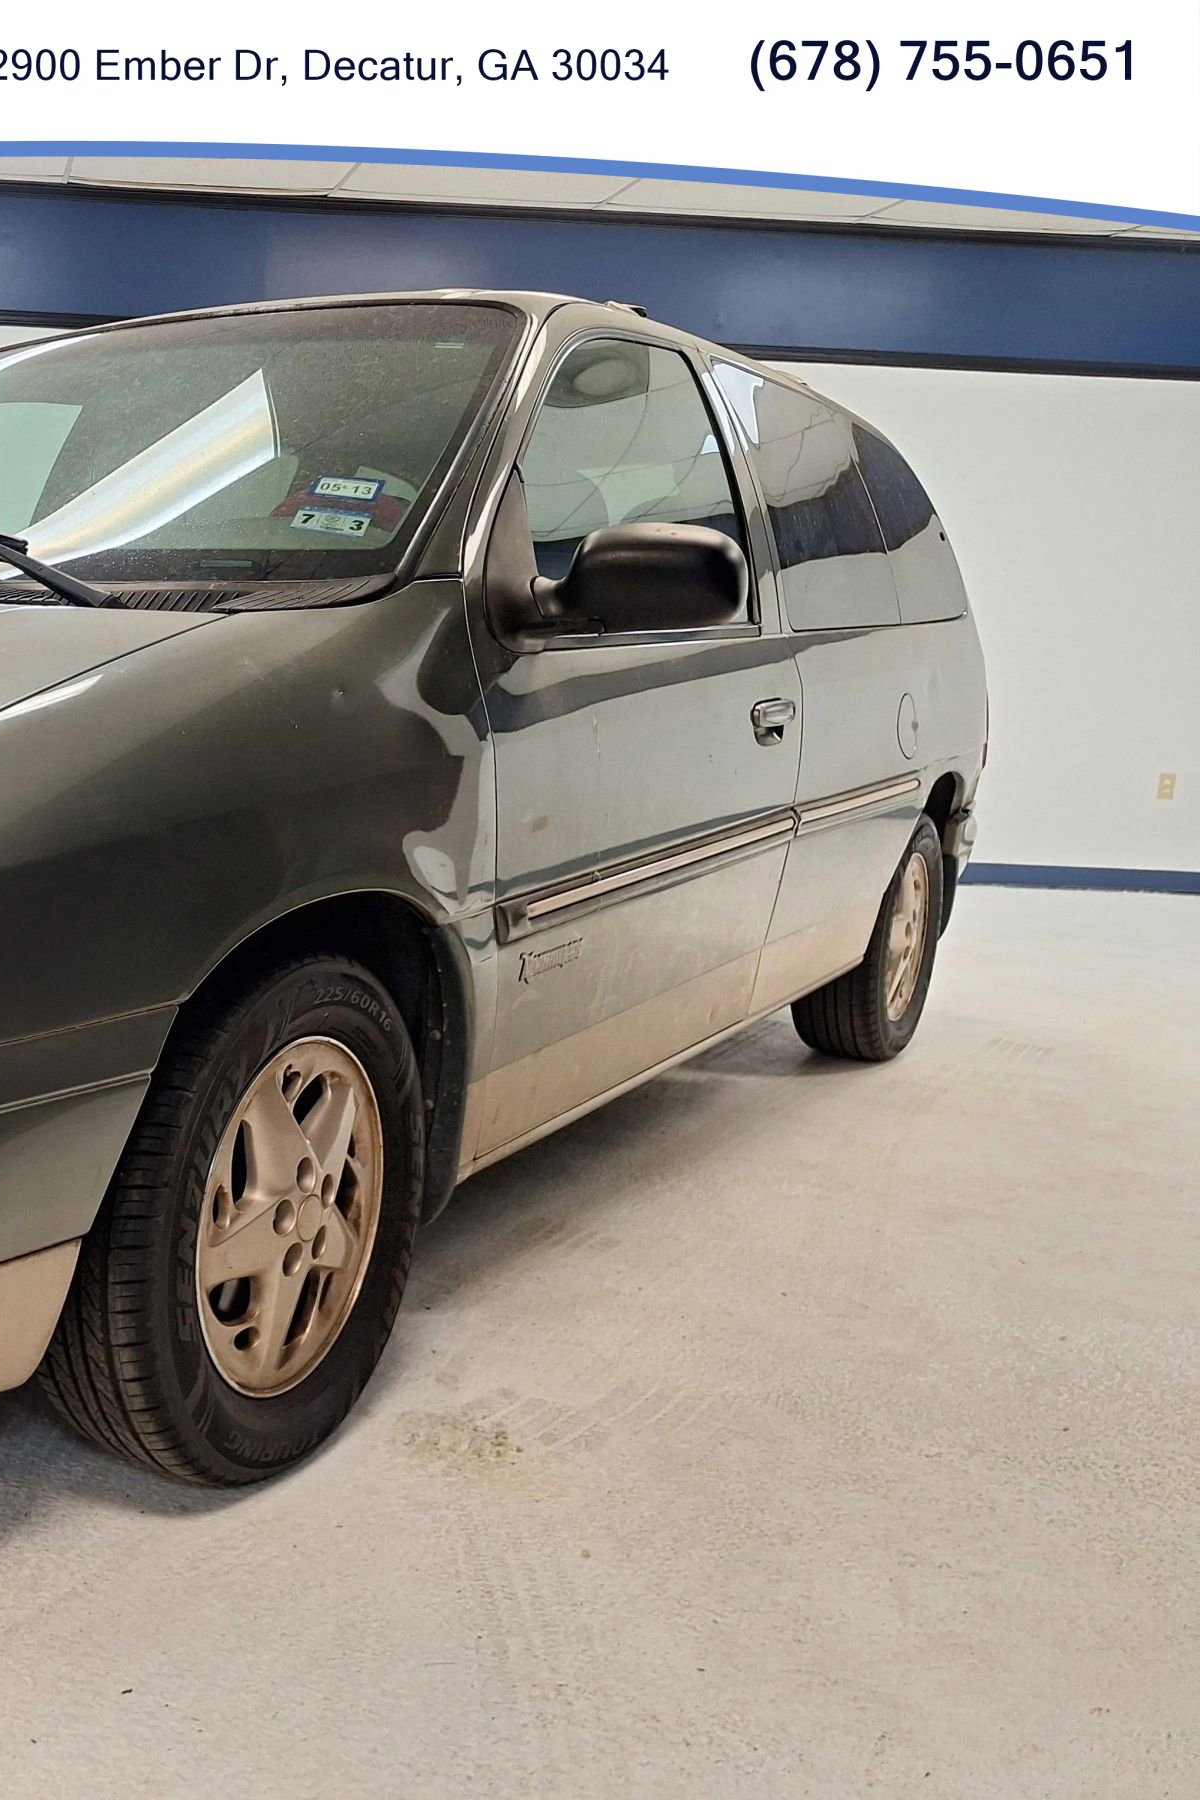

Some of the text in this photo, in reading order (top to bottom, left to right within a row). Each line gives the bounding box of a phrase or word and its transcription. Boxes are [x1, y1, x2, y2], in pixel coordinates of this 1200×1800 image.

[320, 482, 373, 495] 05 13
[301, 513, 315, 524] 7
[349, 519, 365, 531] 3
[313, 986, 393, 1032] 225/60R16
